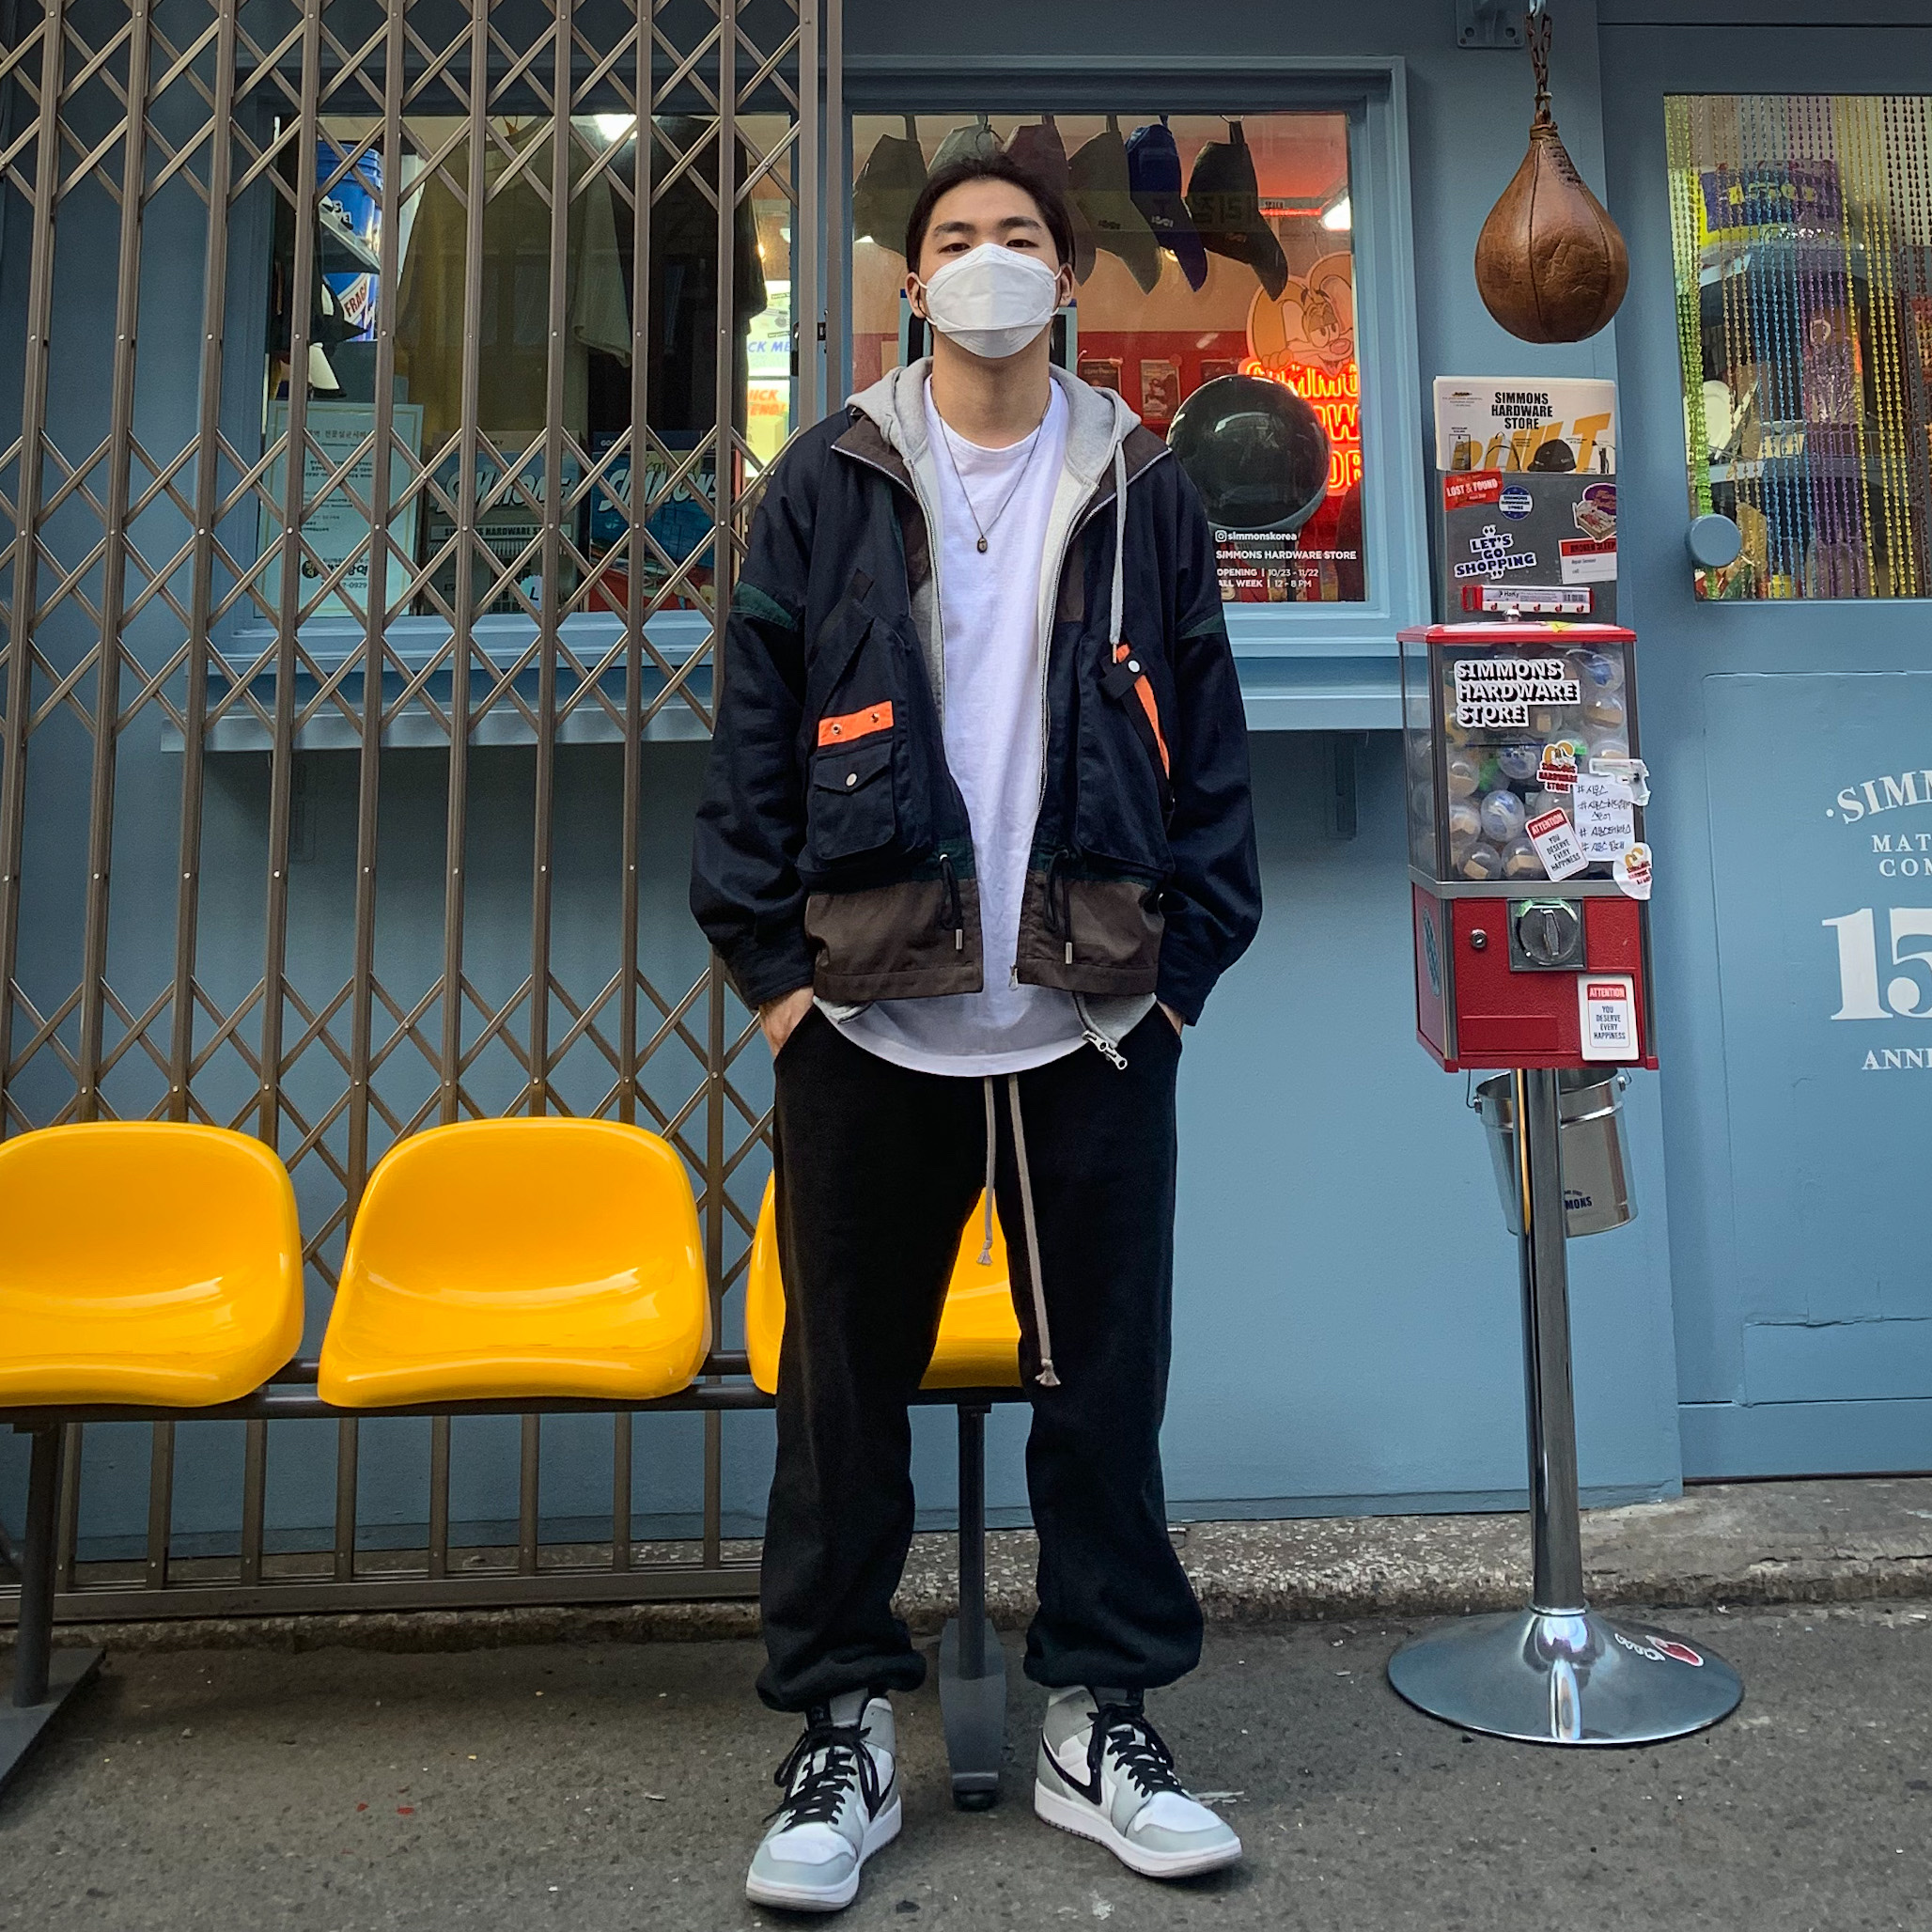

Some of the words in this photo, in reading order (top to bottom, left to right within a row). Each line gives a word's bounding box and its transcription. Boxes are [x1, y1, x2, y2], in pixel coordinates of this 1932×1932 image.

[1495, 392, 1549, 405] SIMMONS
[1491, 405, 1553, 417] HARDWARE
[1504, 417, 1539, 429] STORE
[1446, 484, 1465, 497] LOST
[1227, 532, 1297, 541] simmonskorea
[1472, 535, 1511, 551] LET'S
[1216, 551, 1262, 559] SIMMONS
[1264, 551, 1322, 559] HARDWARE
[1324, 551, 1357, 560] STORE
[1483, 548, 1504, 559] GO
[1457, 554, 1535, 575] SHOPPING
[1269, 569, 1291, 577] 10/23
[1457, 662, 1564, 680] SIMMONS
[1457, 681, 1578, 702] HARDWARE
[1458, 705, 1526, 724] STORE
[1531, 813, 1565, 835] ATTENTION
[1549, 834, 1561, 843] YOU
[1872, 834, 1931, 853] MAT
[1547, 840, 1571, 855] DESERVE
[1553, 848, 1570, 861] EVERY
[1550, 852, 1581, 871] HAPPINESS
[1589, 988, 1625, 998] ATTENTION
[1596, 1014, 1621, 1022] DESERVE
